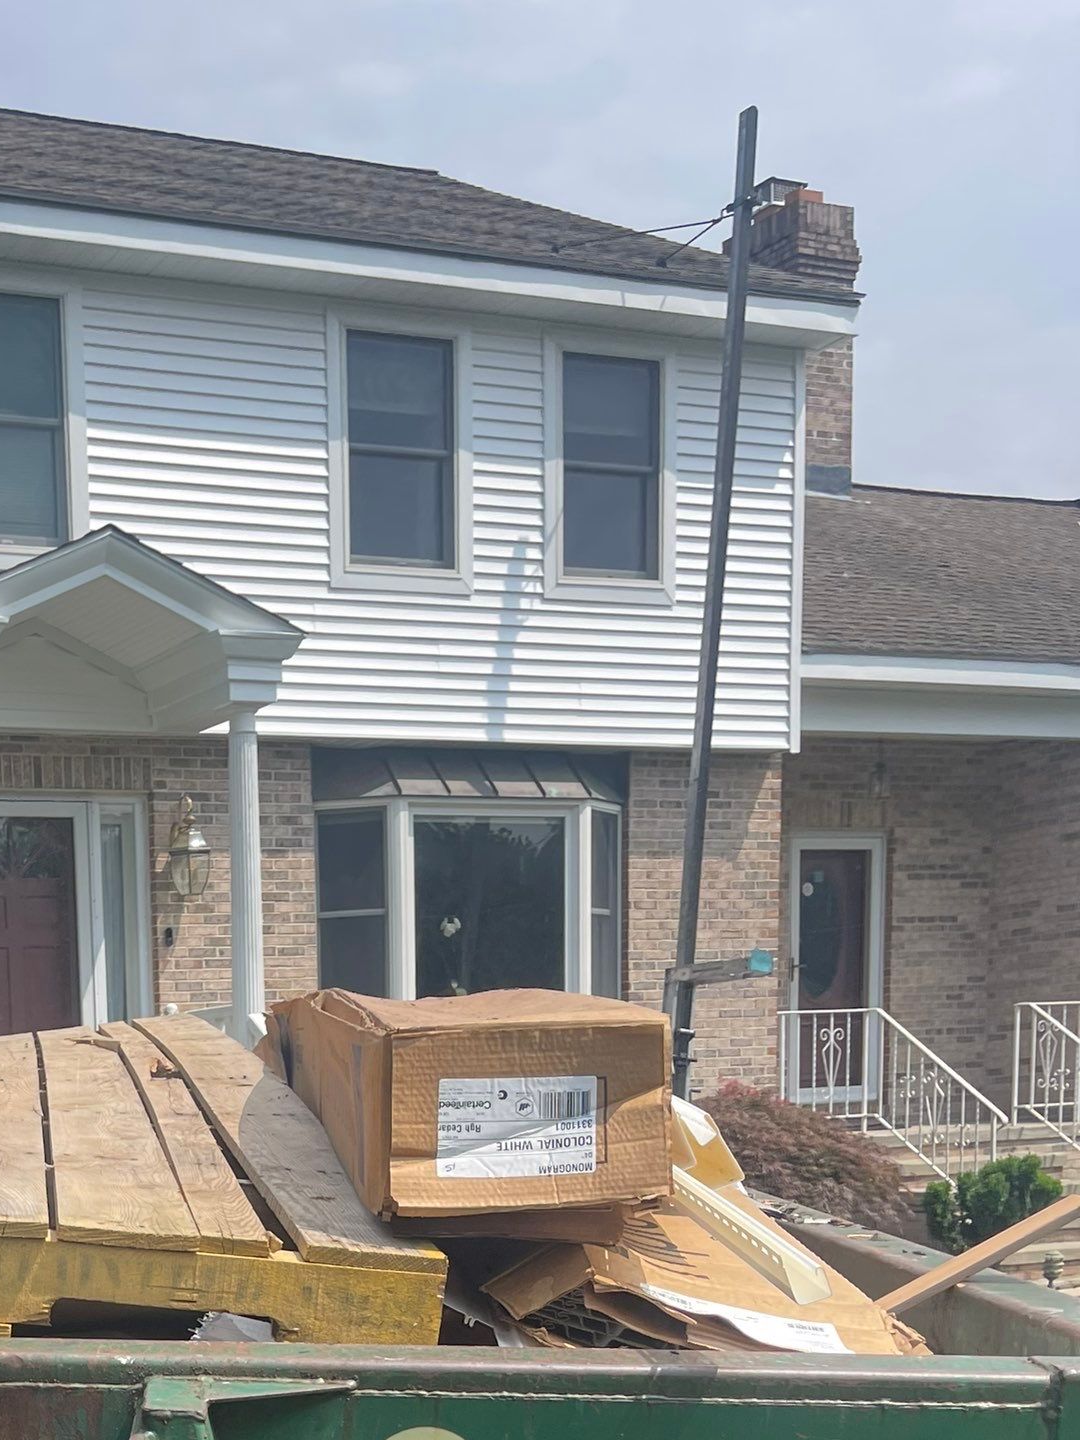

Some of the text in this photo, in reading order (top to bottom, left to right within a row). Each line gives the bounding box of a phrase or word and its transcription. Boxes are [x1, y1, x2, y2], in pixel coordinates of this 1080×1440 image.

[439, 1100, 492, 1110] CertainTeed
[438, 1123, 481, 1134] Rgh Cedar
[555, 1119, 593, 1131] 3311001
[496, 1136, 593, 1151] COLONIAL WHITE
[538, 1162, 593, 1174] MONOGRAM
